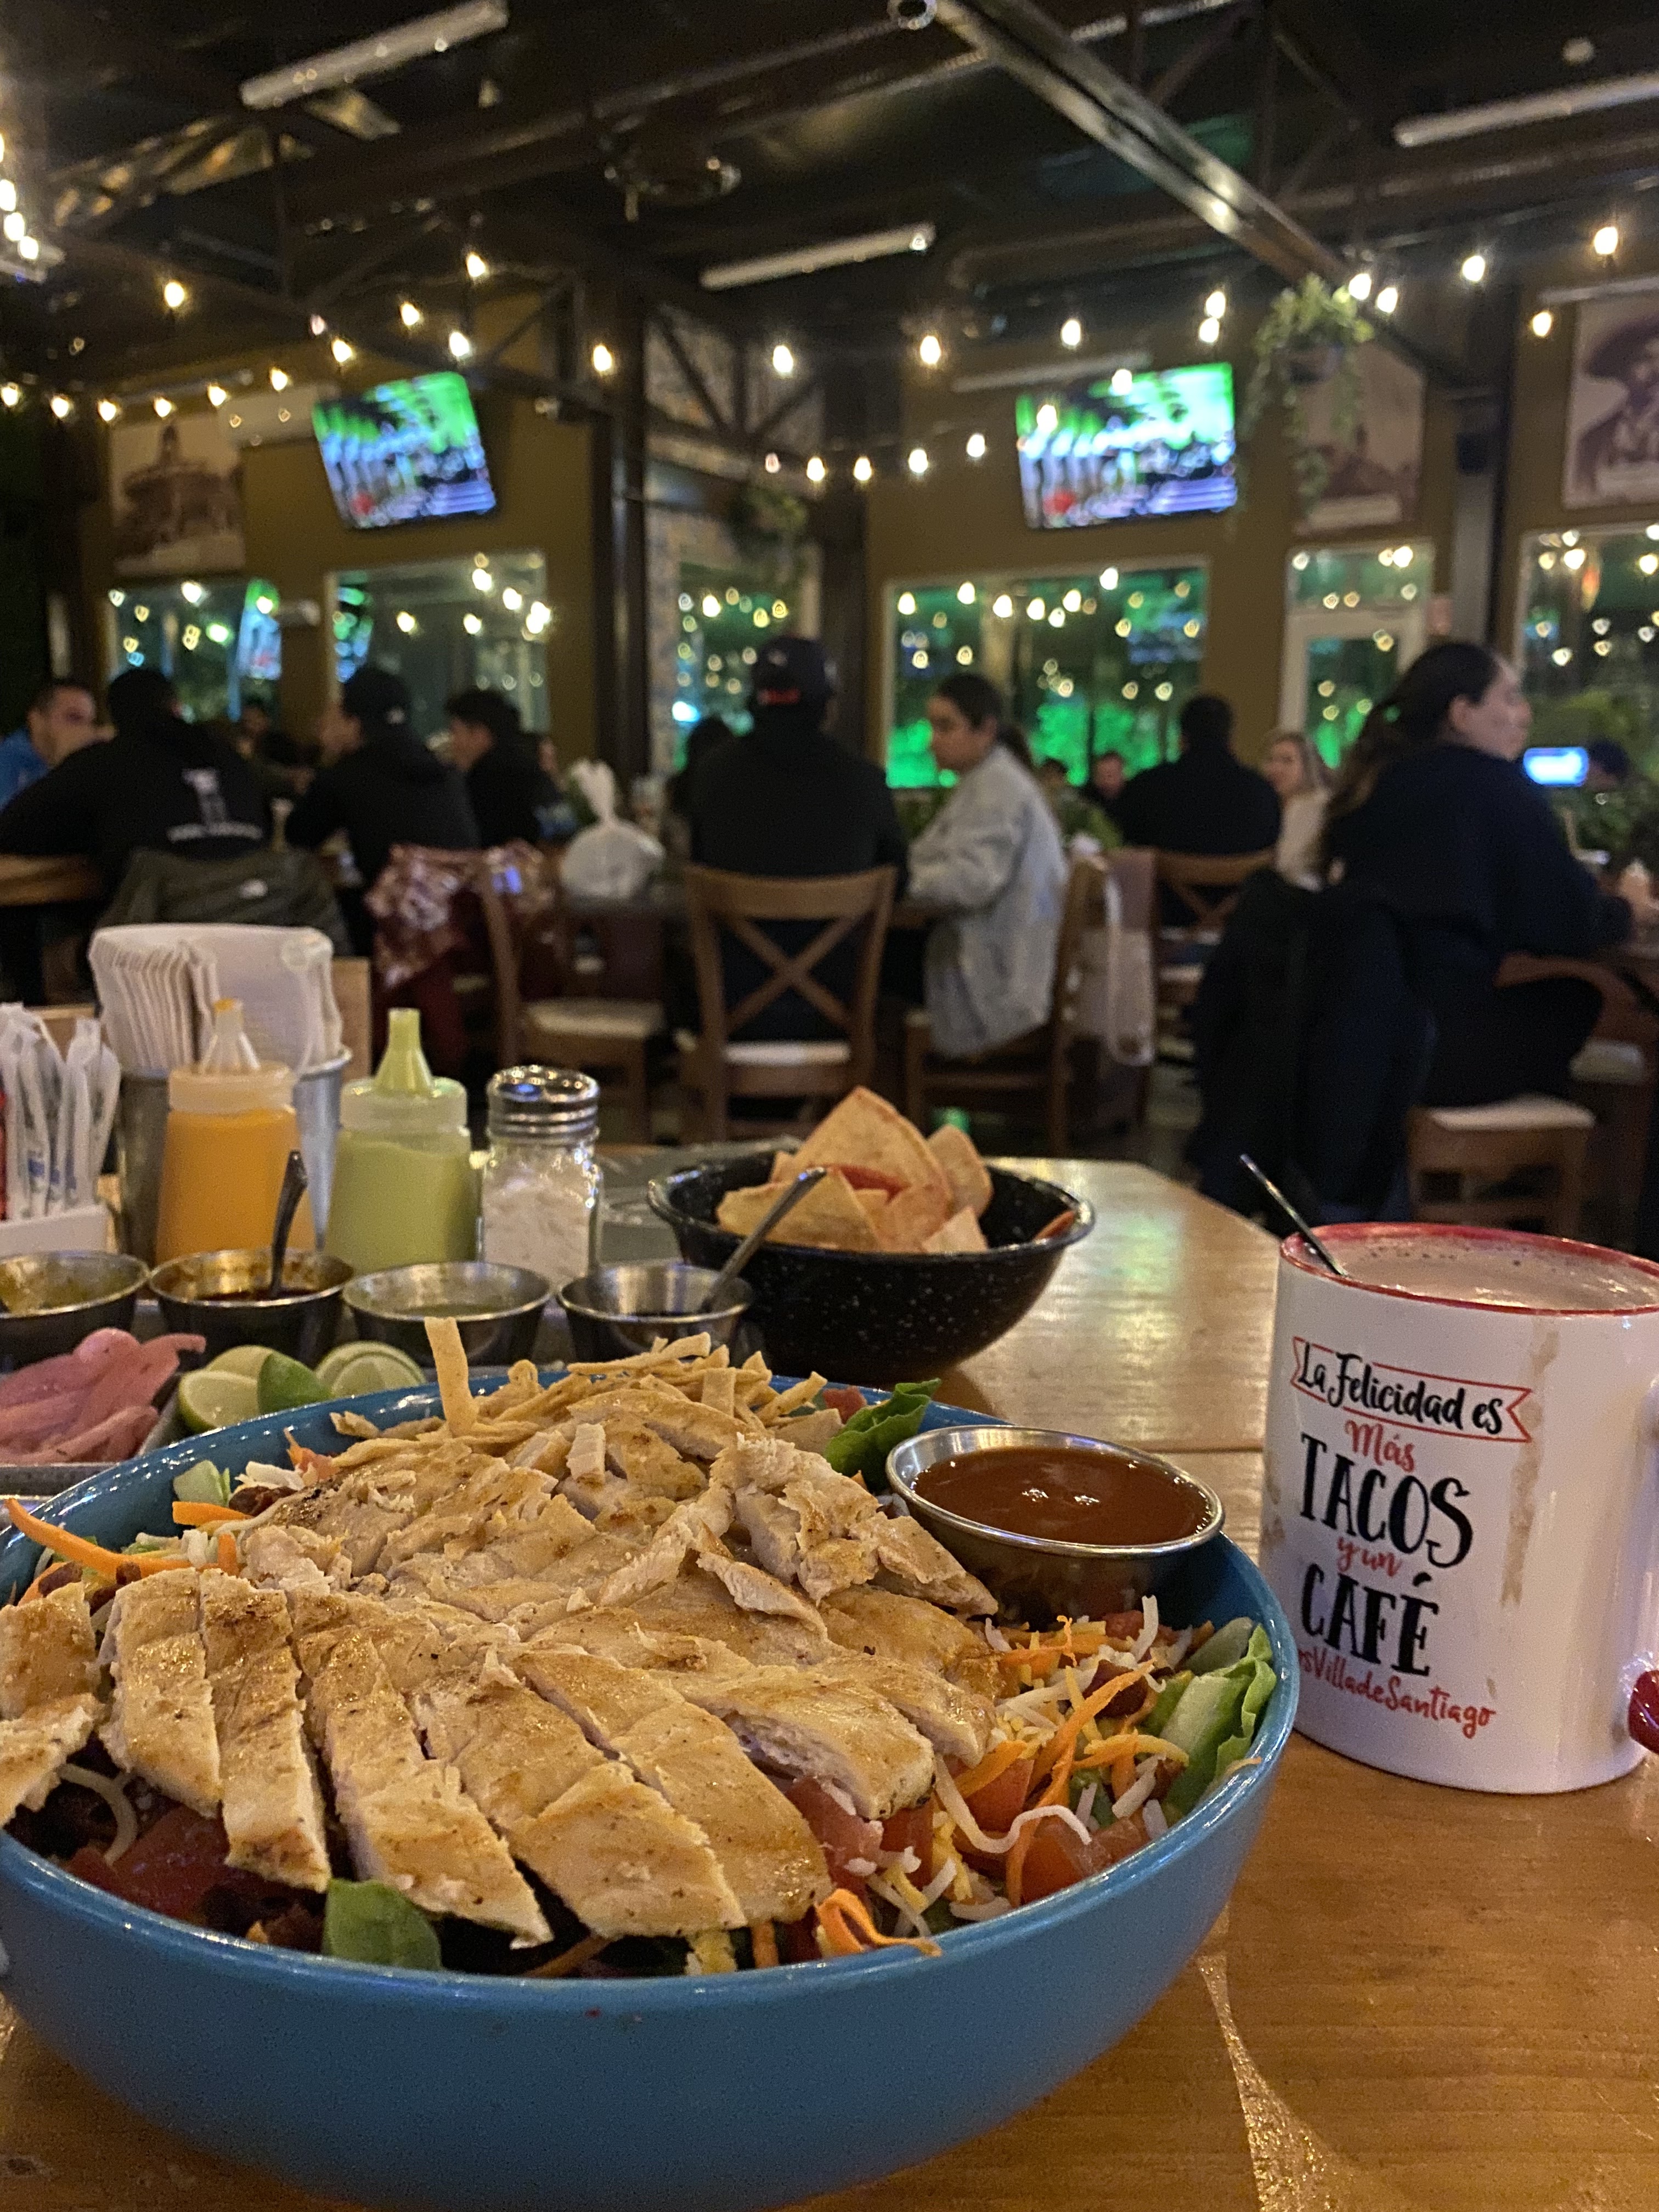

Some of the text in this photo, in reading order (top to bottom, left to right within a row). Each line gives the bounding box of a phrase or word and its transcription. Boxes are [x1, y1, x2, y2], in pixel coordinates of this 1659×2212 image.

[1298, 1342, 1503, 1435] La Felicidad es
[1345, 1420, 1415, 1472] Más
[1300, 1432, 1474, 1568] TACOS
[1301, 1564, 1439, 1677] CAFÉ
